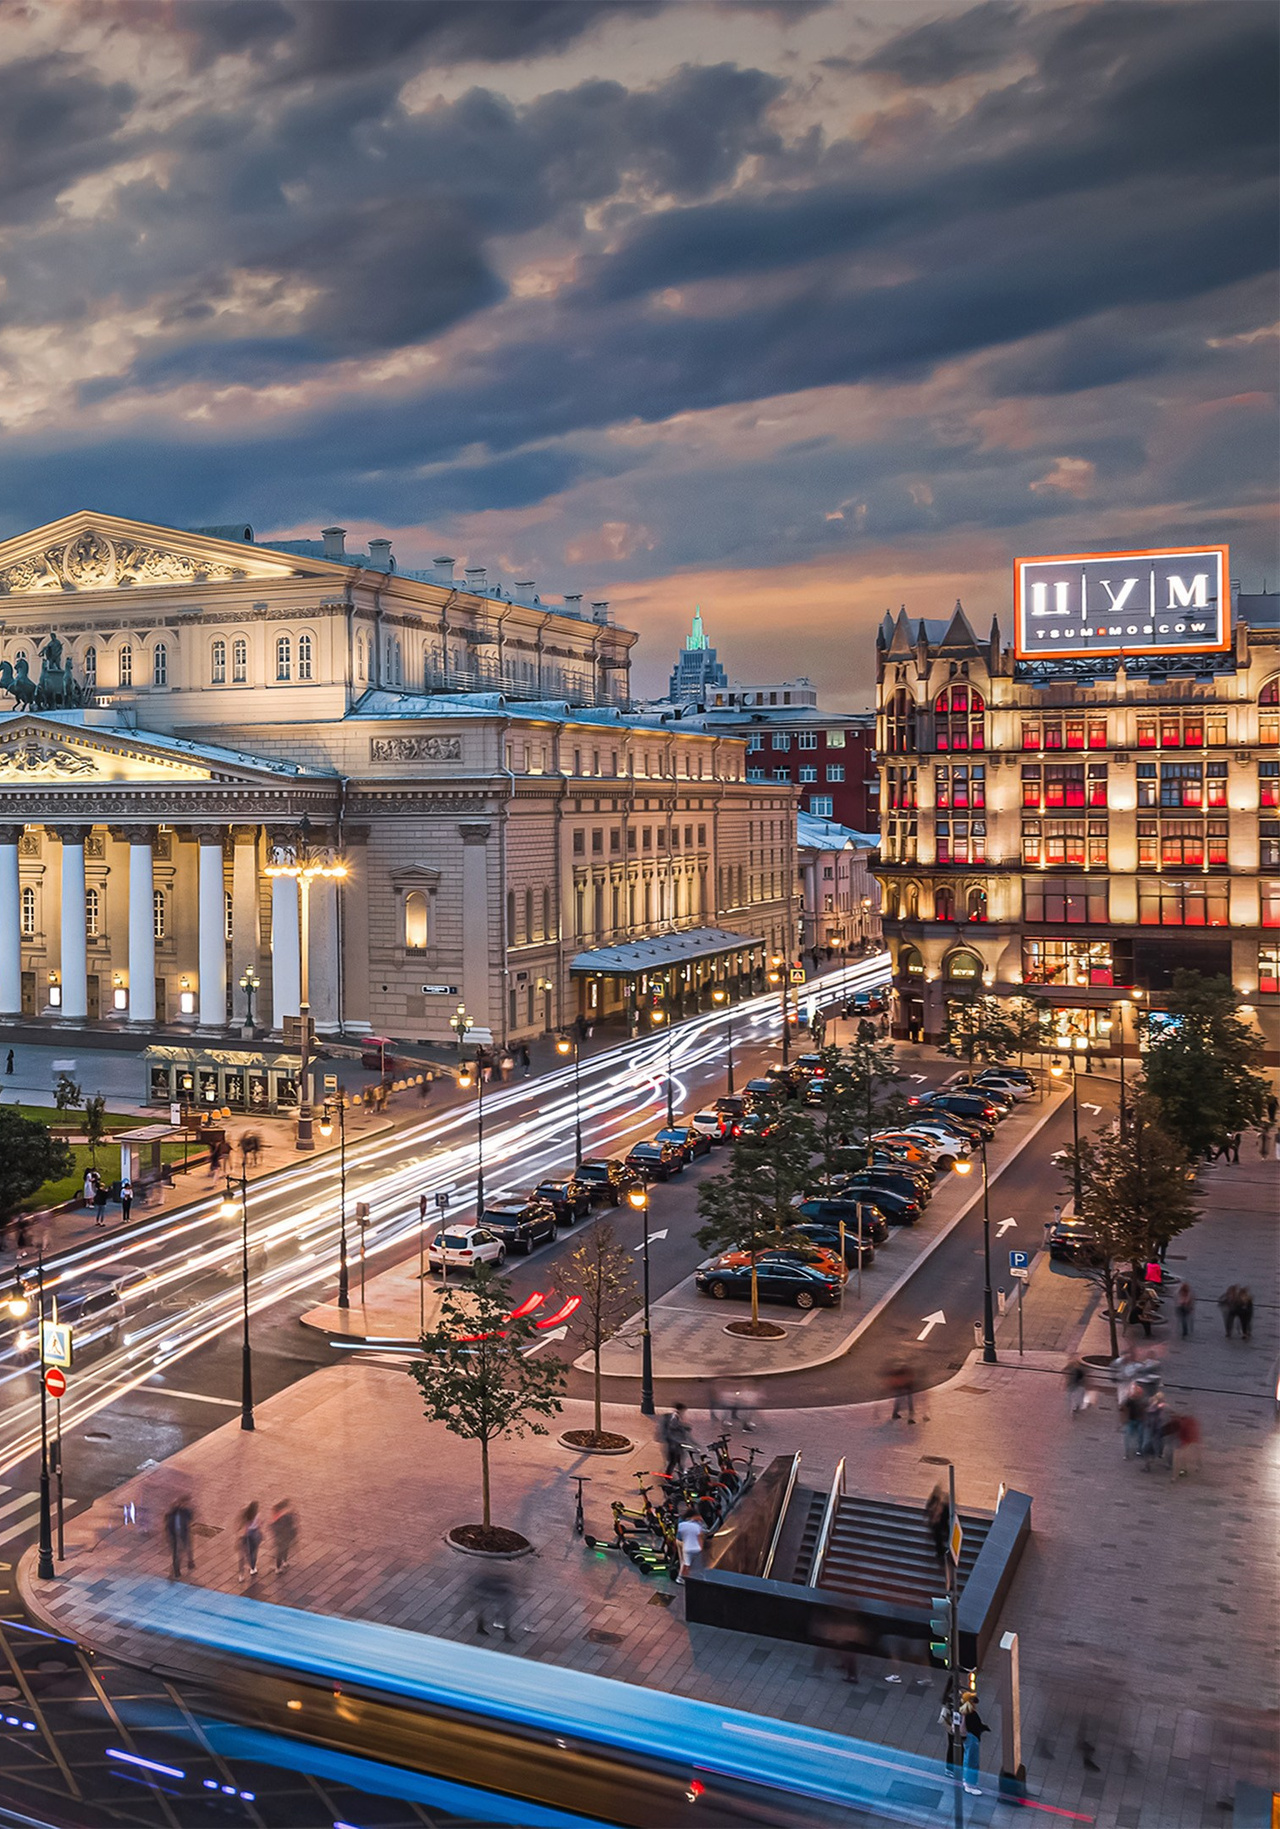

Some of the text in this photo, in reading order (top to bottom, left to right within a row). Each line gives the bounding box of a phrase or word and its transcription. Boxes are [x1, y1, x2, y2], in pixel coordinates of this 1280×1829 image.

[1036, 622, 1207, 639] TSUM MOSCOW
[1014, 1253, 1025, 1266] P
